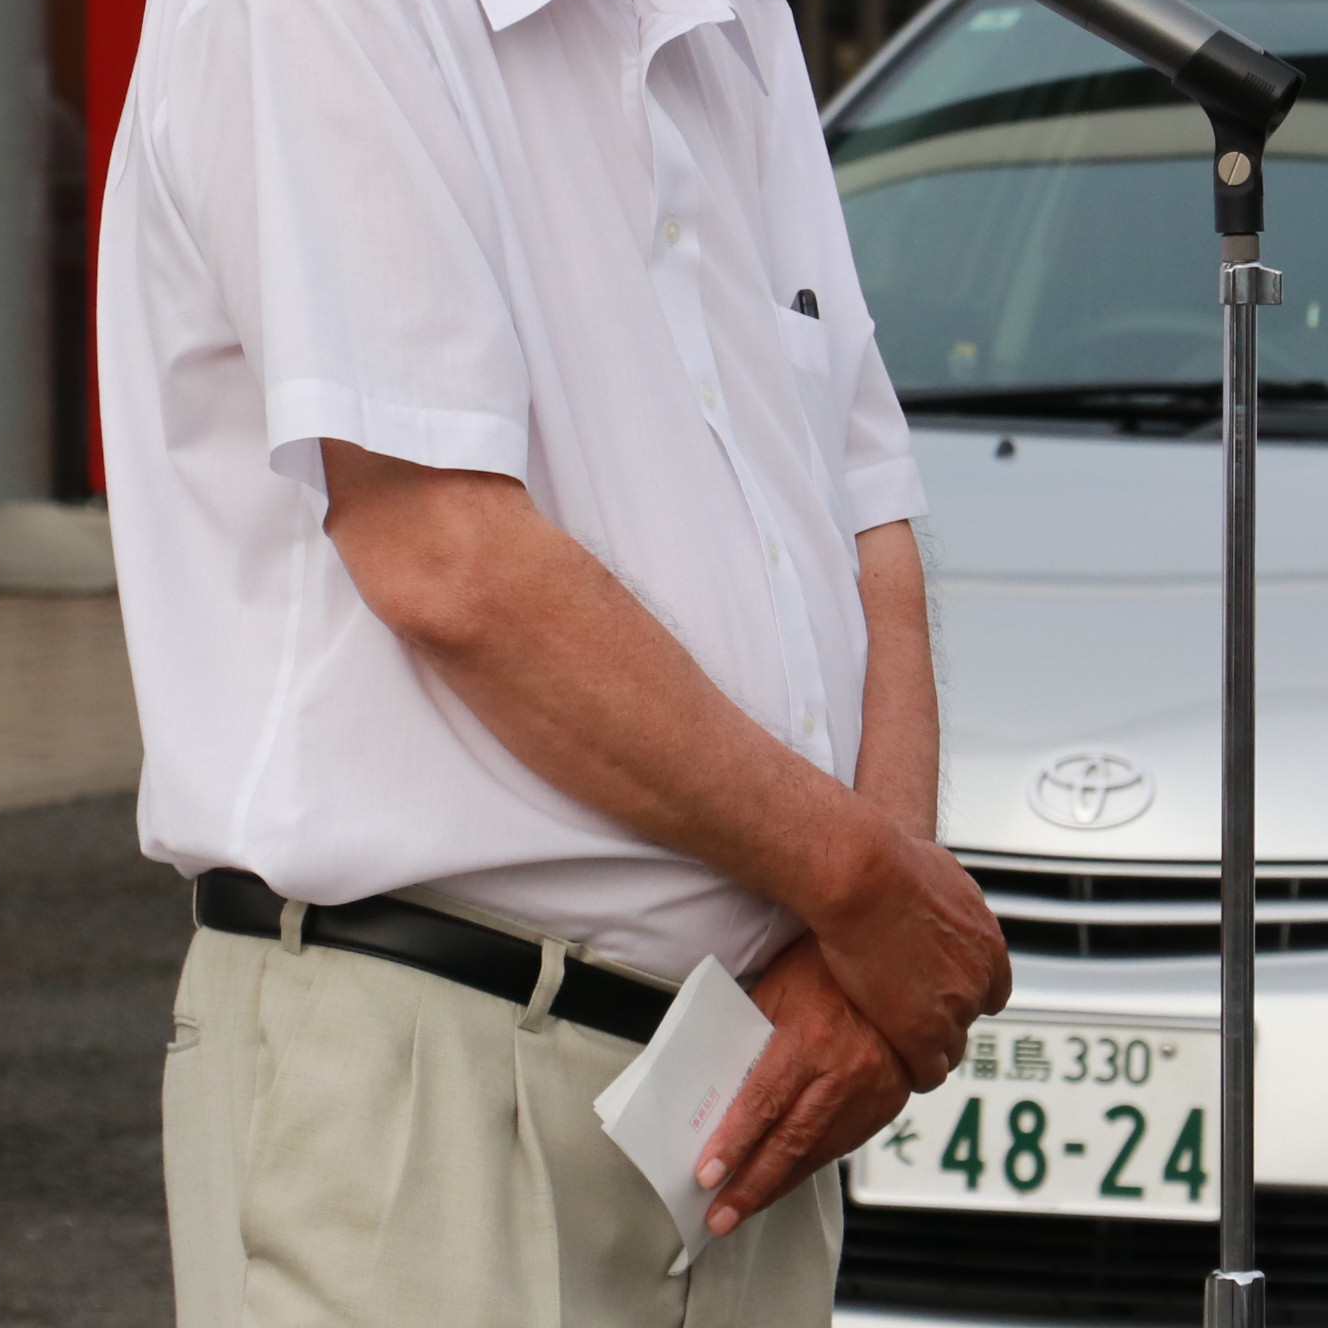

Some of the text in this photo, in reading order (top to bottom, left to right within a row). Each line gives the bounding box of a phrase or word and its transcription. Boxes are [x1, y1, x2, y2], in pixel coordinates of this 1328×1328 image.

[958, 1033, 1152, 1086] 福島 330
[940, 1096, 1207, 1202] 48-24
